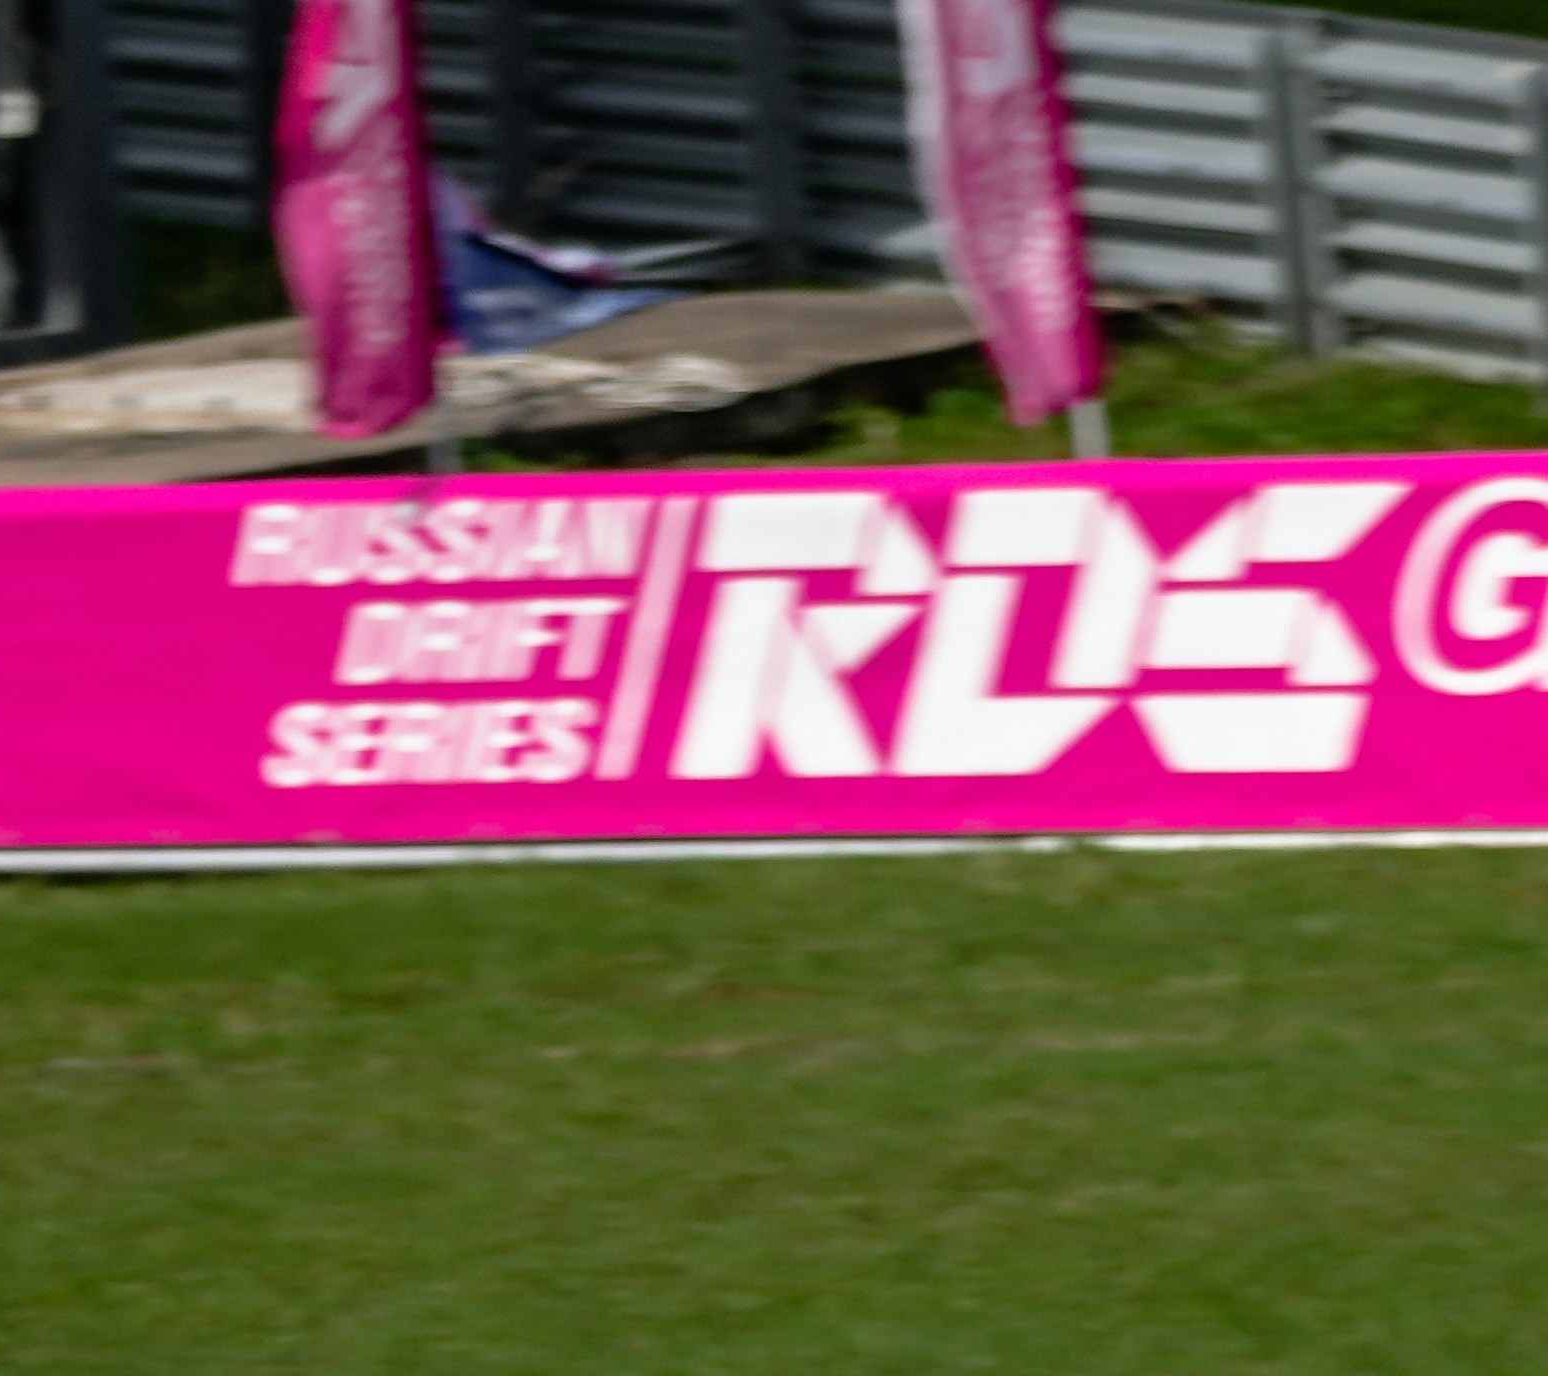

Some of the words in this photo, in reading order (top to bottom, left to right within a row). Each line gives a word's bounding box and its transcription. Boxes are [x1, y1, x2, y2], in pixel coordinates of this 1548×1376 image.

[230, 498, 649, 586] RUSSIAN
[333, 597, 630, 685] DRIFT
[669, 484, 1414, 780] RDS
[259, 697, 598, 788] SERIES
